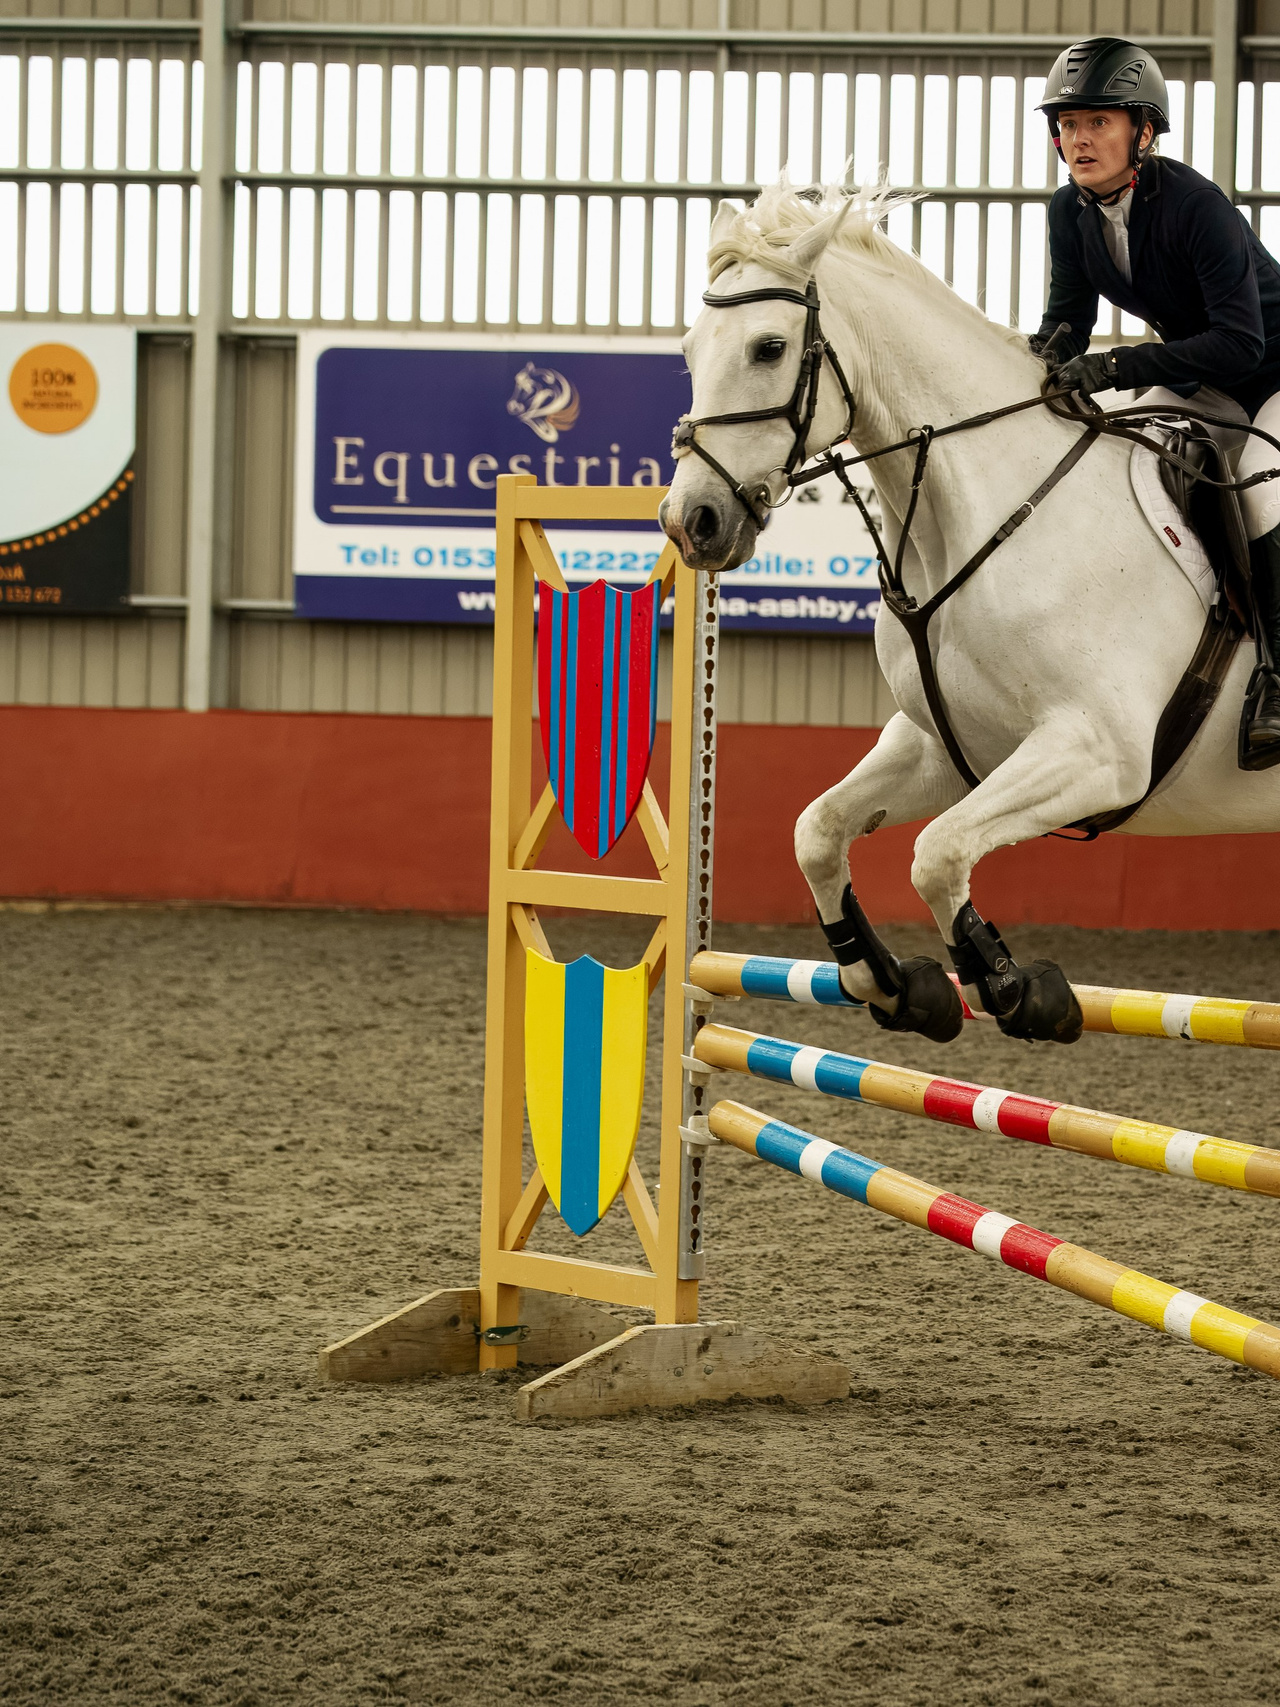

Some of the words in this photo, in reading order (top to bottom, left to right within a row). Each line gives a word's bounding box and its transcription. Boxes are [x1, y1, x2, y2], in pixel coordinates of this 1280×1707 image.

[332, 436, 661, 503] Equestria
[340, 545, 399, 566] Tel:
[413, 547, 496, 568] 0153
[559, 551, 661, 571] 12222
